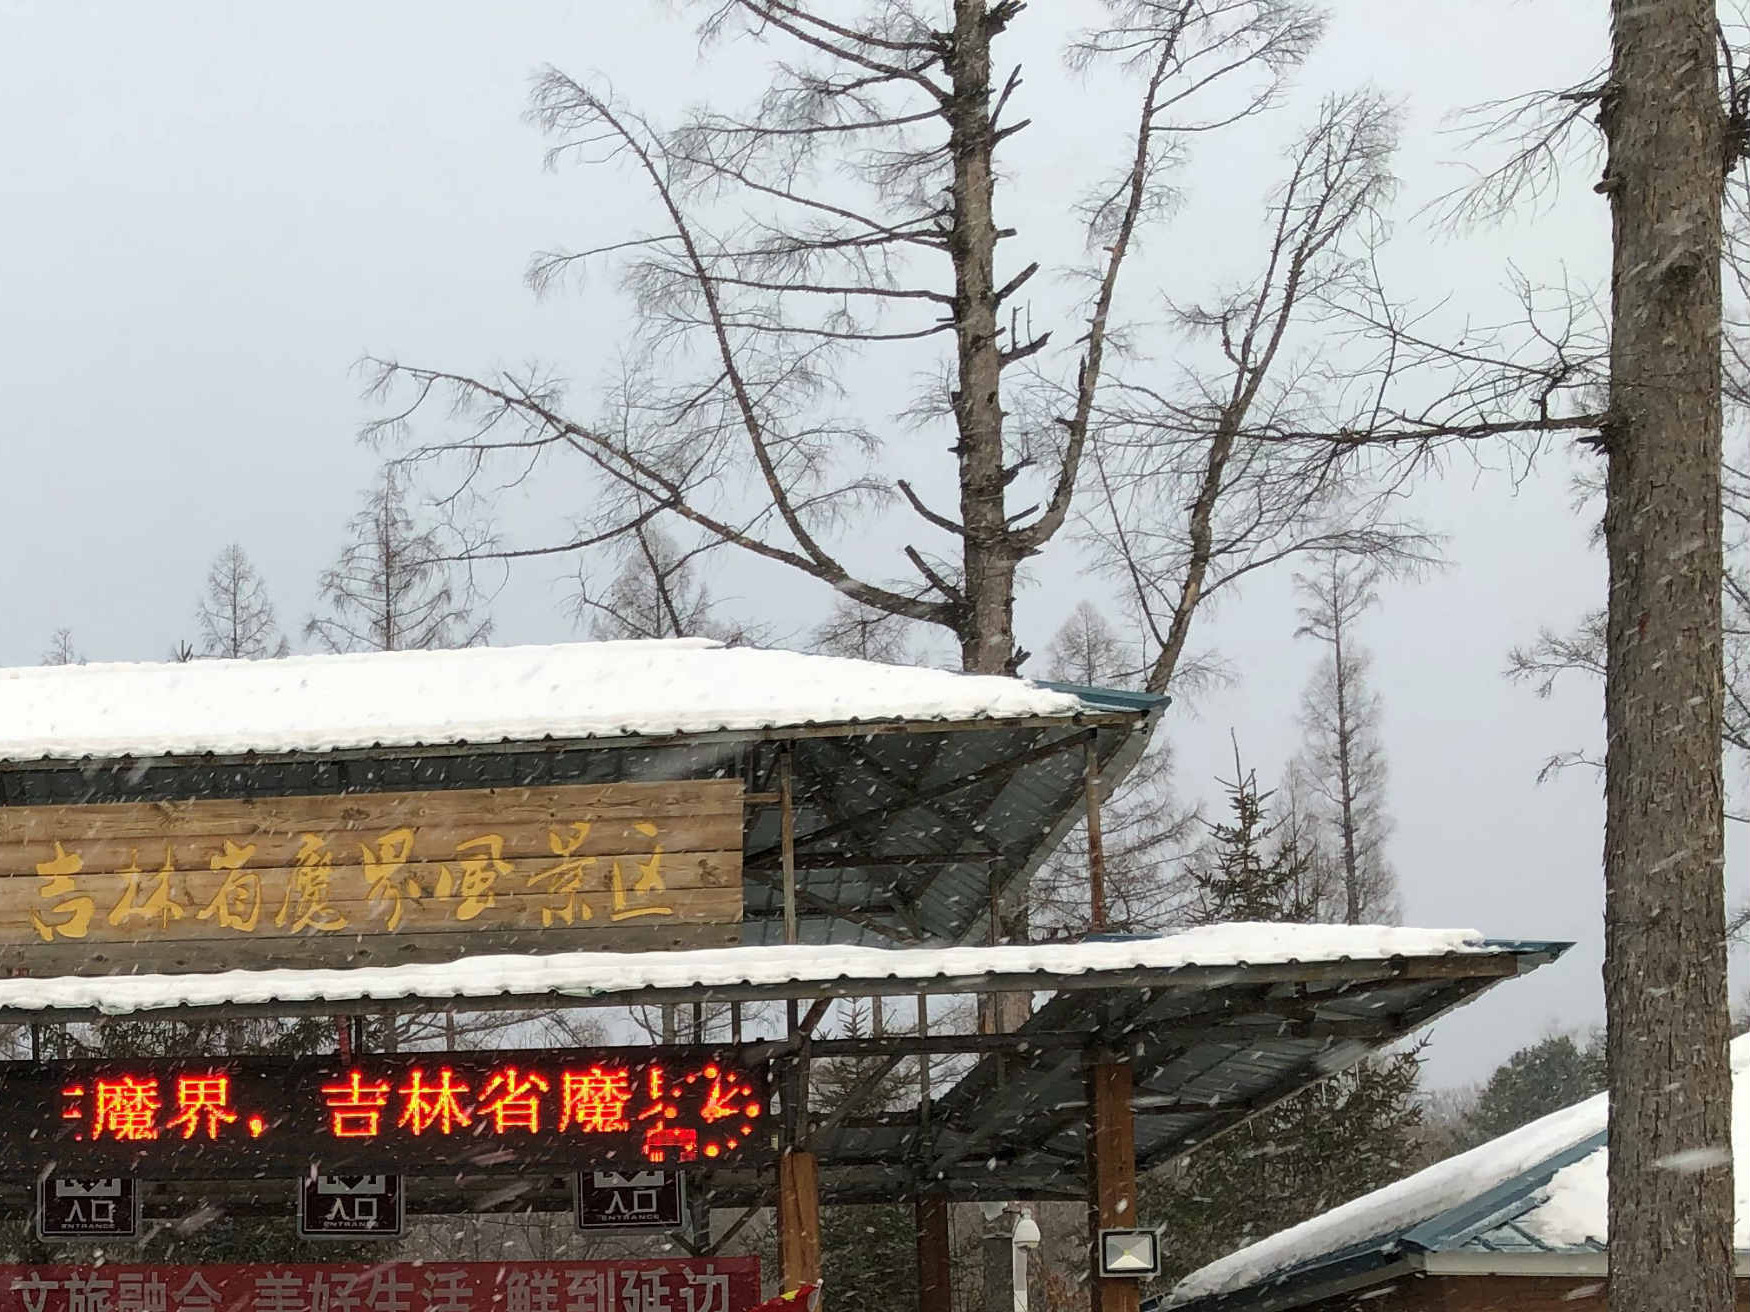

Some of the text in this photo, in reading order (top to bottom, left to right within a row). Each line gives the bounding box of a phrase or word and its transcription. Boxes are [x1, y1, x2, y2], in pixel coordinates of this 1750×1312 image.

[65, 1199, 114, 1223] 入口
[330, 1198, 378, 1221] 入口
[608, 1190, 657, 1213] 入口
[324, 1220, 378, 1228] ENTRANCE
[602, 1213, 659, 1221] ENTRANCE
